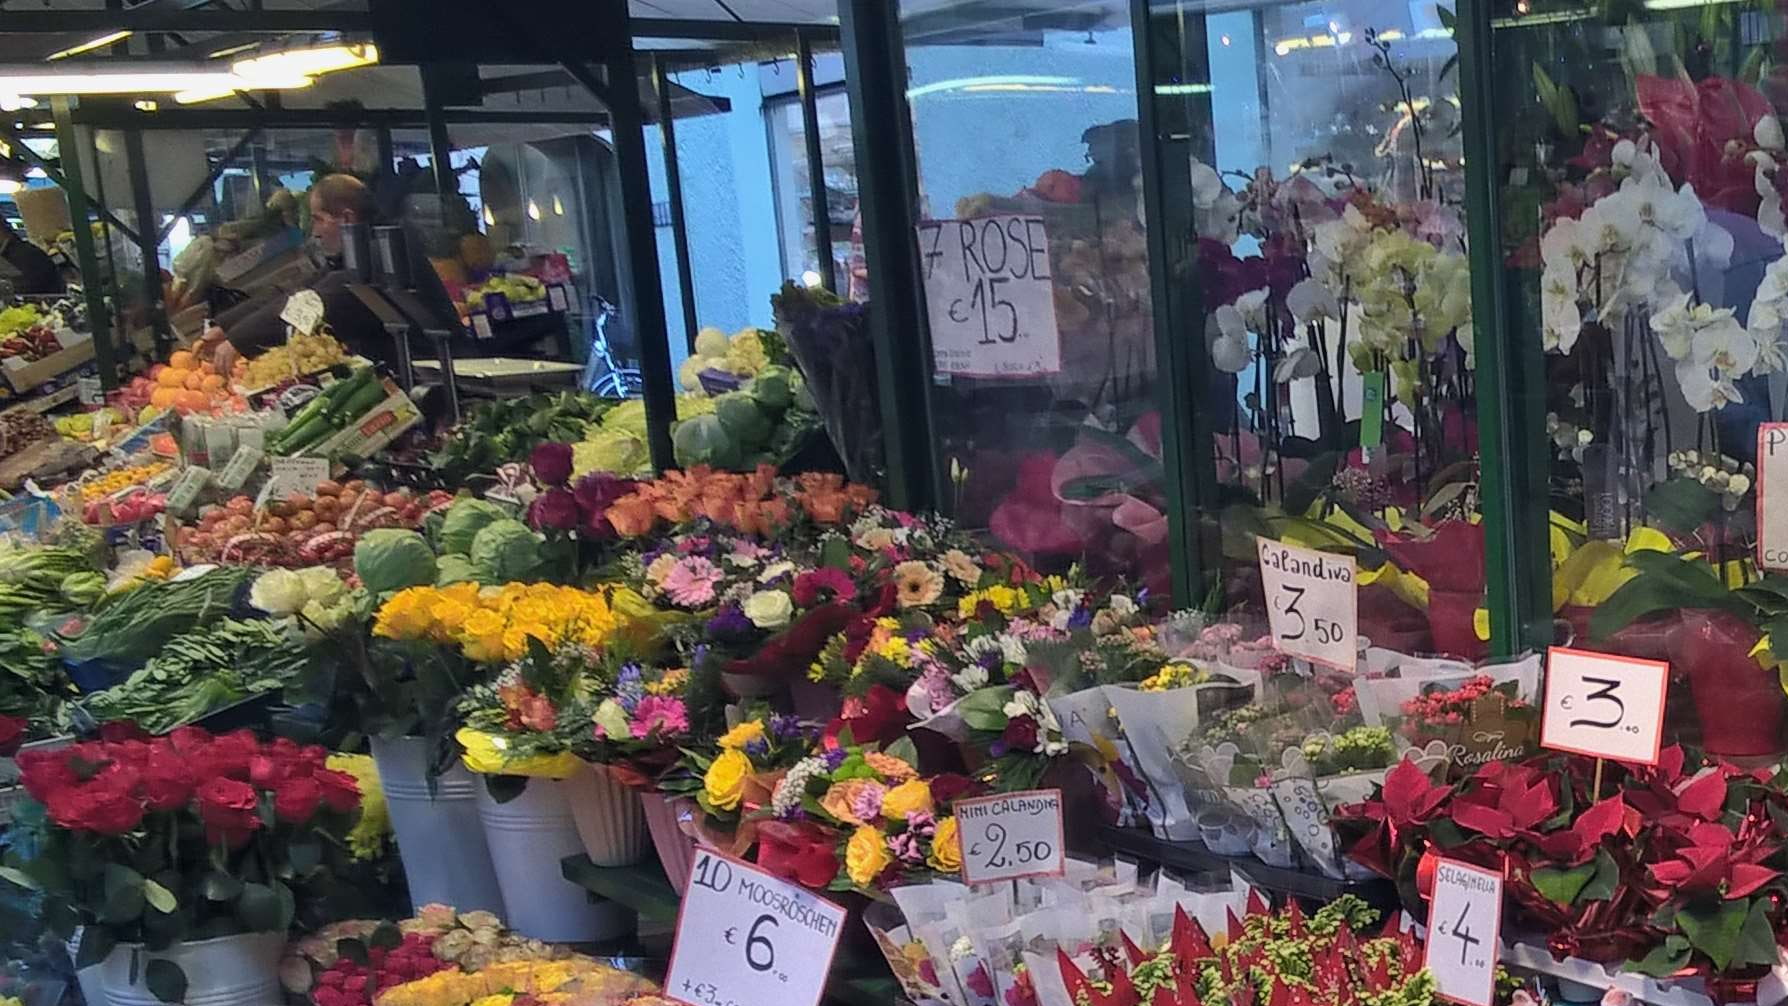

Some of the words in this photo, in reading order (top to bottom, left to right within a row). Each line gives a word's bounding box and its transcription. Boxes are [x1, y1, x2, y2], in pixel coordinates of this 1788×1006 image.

[920, 225, 943, 279] 7
[960, 217, 1052, 283] ROSE
[1261, 543, 1352, 582] Calandiva
[1448, 733, 1525, 767] Rosalina
[959, 805, 988, 820] MINI
[693, 855, 732, 892] 10
